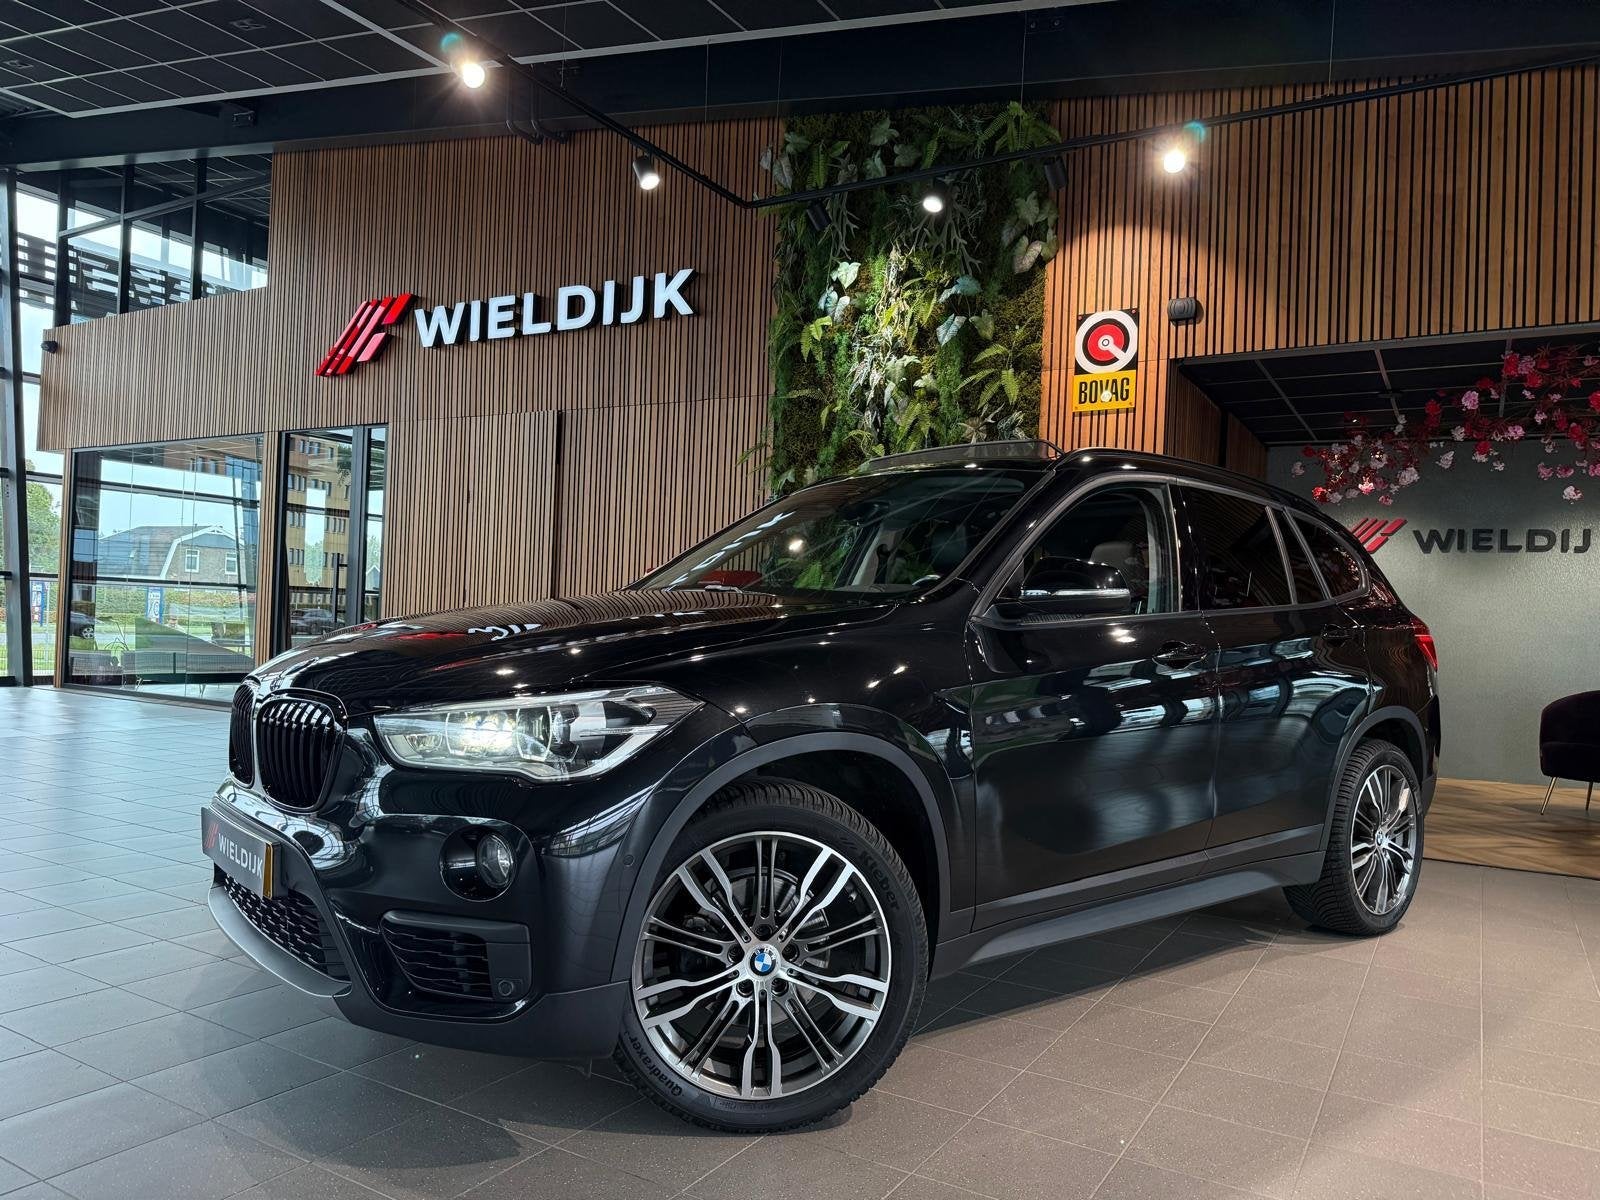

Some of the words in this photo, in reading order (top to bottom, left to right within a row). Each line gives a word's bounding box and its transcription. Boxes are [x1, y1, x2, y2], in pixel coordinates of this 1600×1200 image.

[414, 269, 695, 349] WIELDIJK
[1413, 528, 1591, 554] WIELDIJ
[218, 832, 263, 879] WIELDIJK
[628, 1035, 683, 1097] Quadraxer
